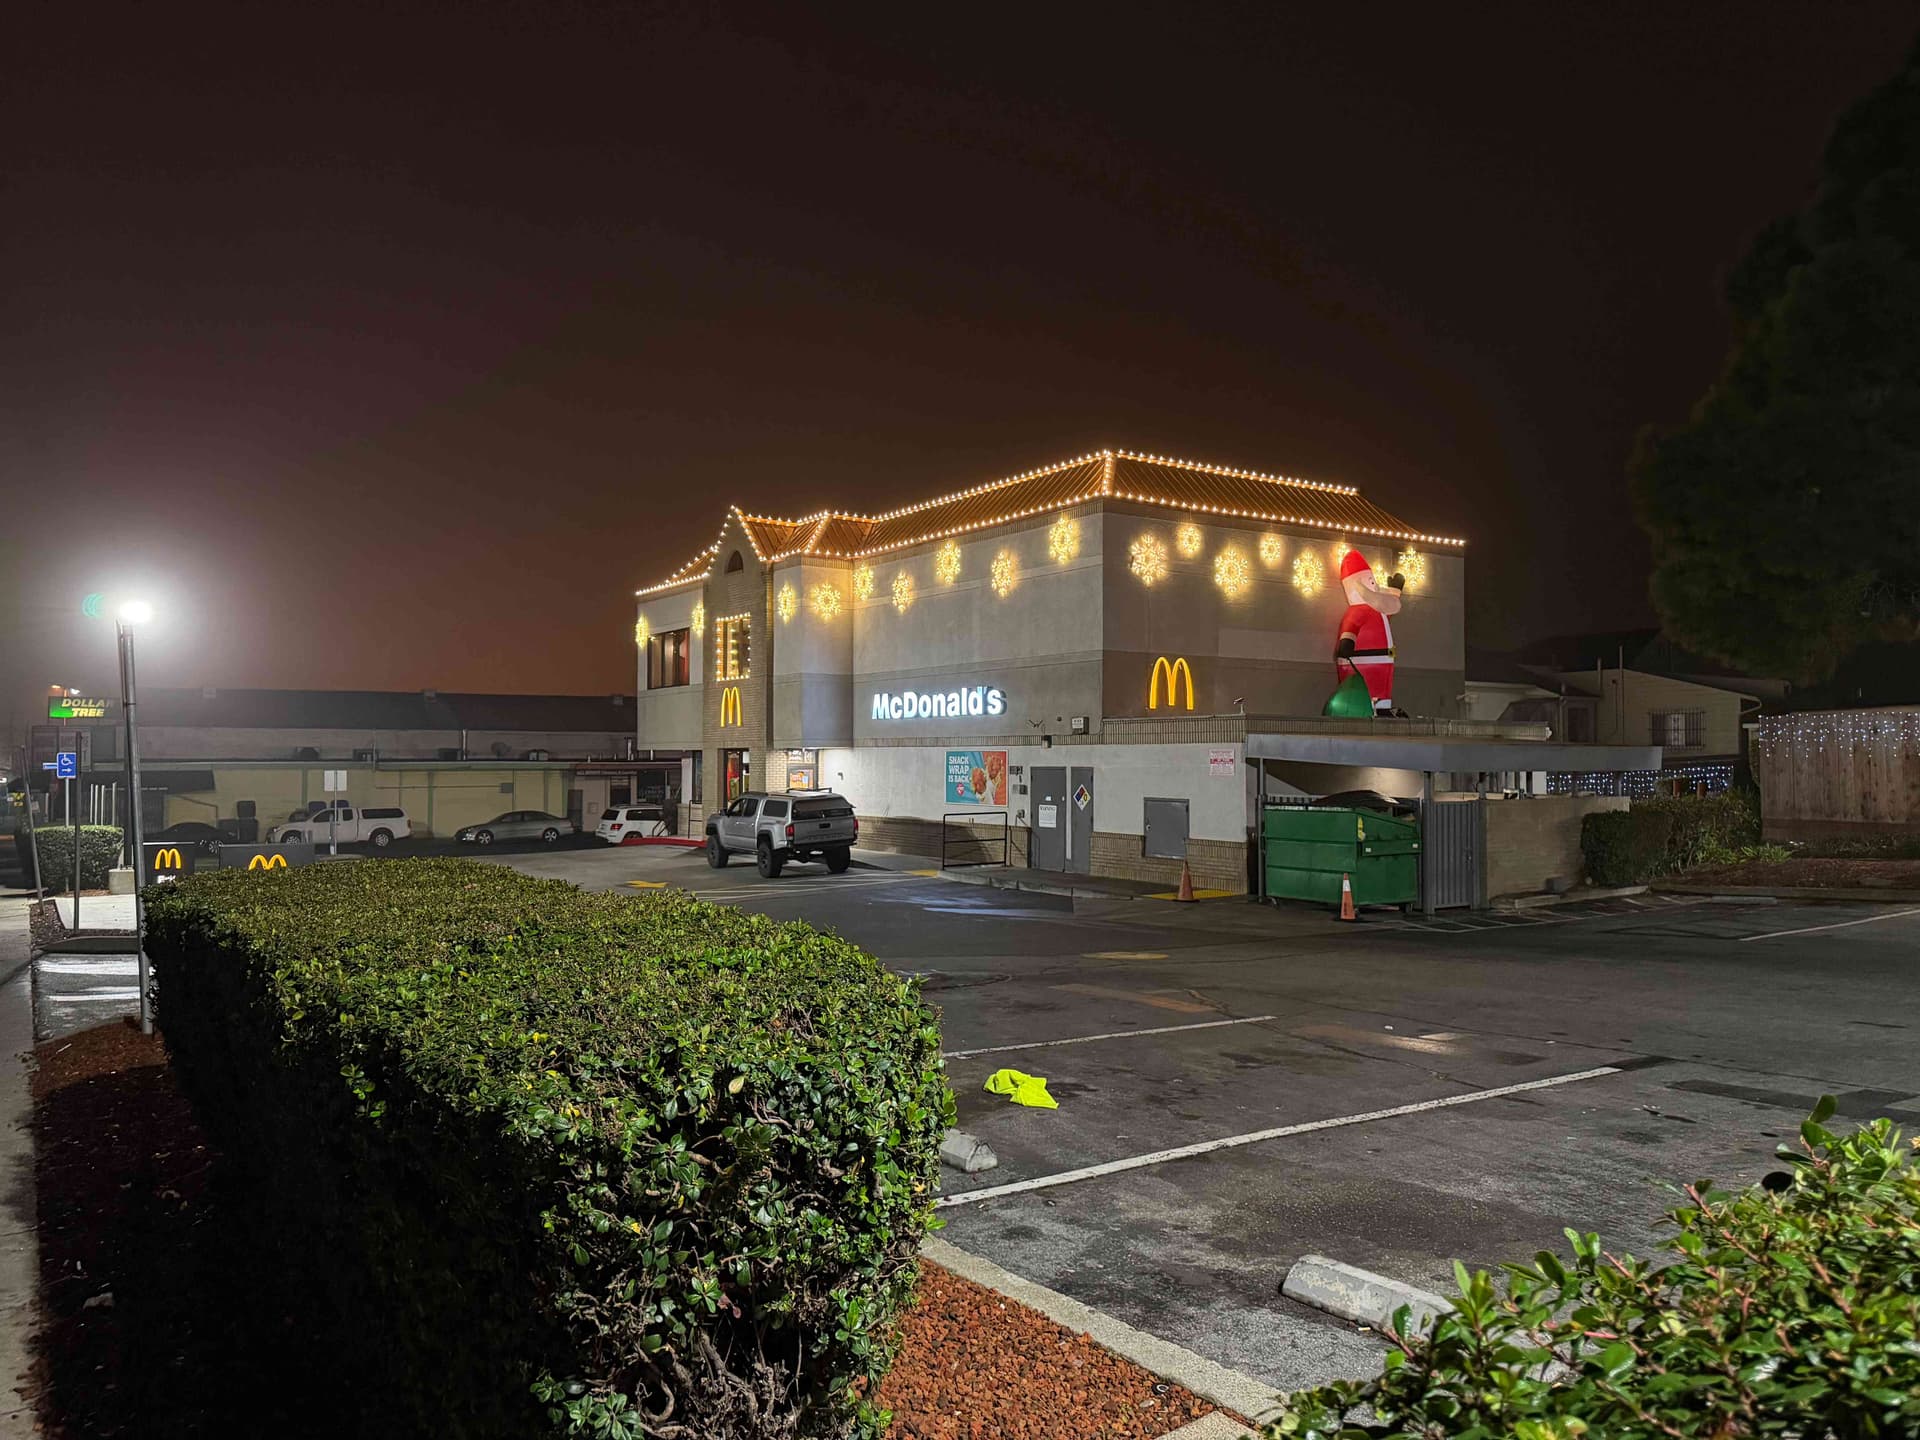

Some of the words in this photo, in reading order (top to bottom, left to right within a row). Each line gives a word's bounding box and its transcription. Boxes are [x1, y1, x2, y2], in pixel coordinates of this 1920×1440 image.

[871, 686, 1005, 720] McDonald's
[71, 708, 104, 717] TREE
[948, 765, 970, 775] WRAP
